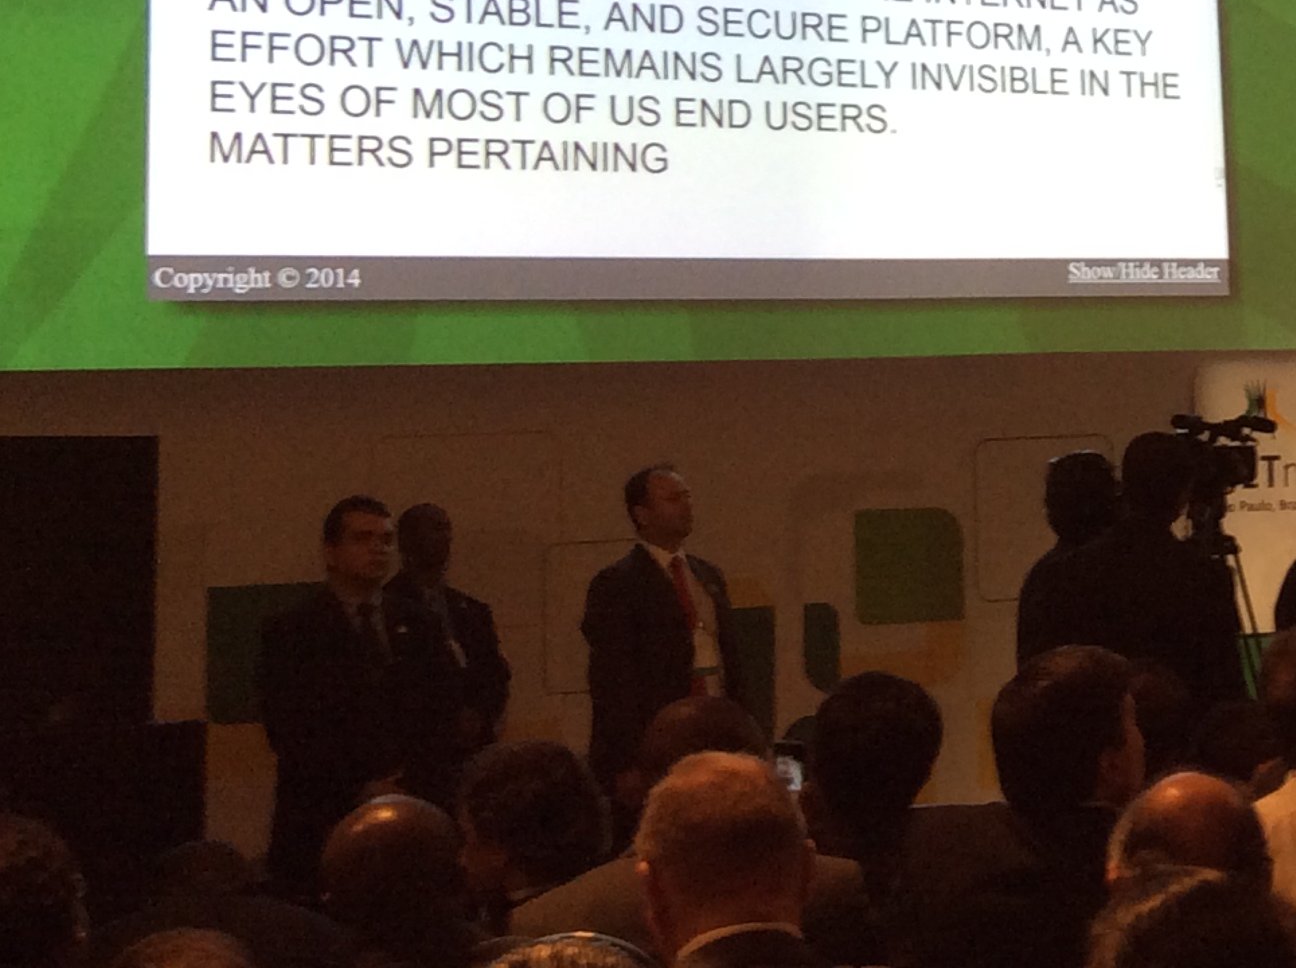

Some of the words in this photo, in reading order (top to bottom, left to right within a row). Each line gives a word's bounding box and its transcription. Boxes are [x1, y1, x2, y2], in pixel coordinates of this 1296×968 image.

[603, 1, 683, 34] AND
[696, 5, 848, 42] SECURE
[861, 15, 1050, 54] PLATFORM,
[1061, 26, 1083, 53] A
[1092, 27, 1152, 56] KEY
[211, 29, 382, 67] EFFORT
[395, 37, 533, 74] WHICH
[549, 45, 722, 82] REMAINS
[736, 54, 898, 88] LARGELY
[911, 62, 1069, 95] INVISIBLE
[1080, 69, 1109, 96] IN
[1119, 70, 1180, 99] THE
[210, 80, 324, 116] EYES
[340, 84, 397, 117] OF
[413, 87, 529, 122] MOST
[542, 91, 595, 124] OF
[609, 95, 661, 126] US
[674, 97, 751, 128] END
[765, 100, 895, 134] USERS.
[210, 131, 413, 168] MATTERS
[429, 137, 668, 174] PERTAINING
[154, 266, 272, 294] Copyright
[305, 267, 362, 289] 2014
[1068, 262, 1159, 280] Show/Hide
[1162, 262, 1221, 280] Header
